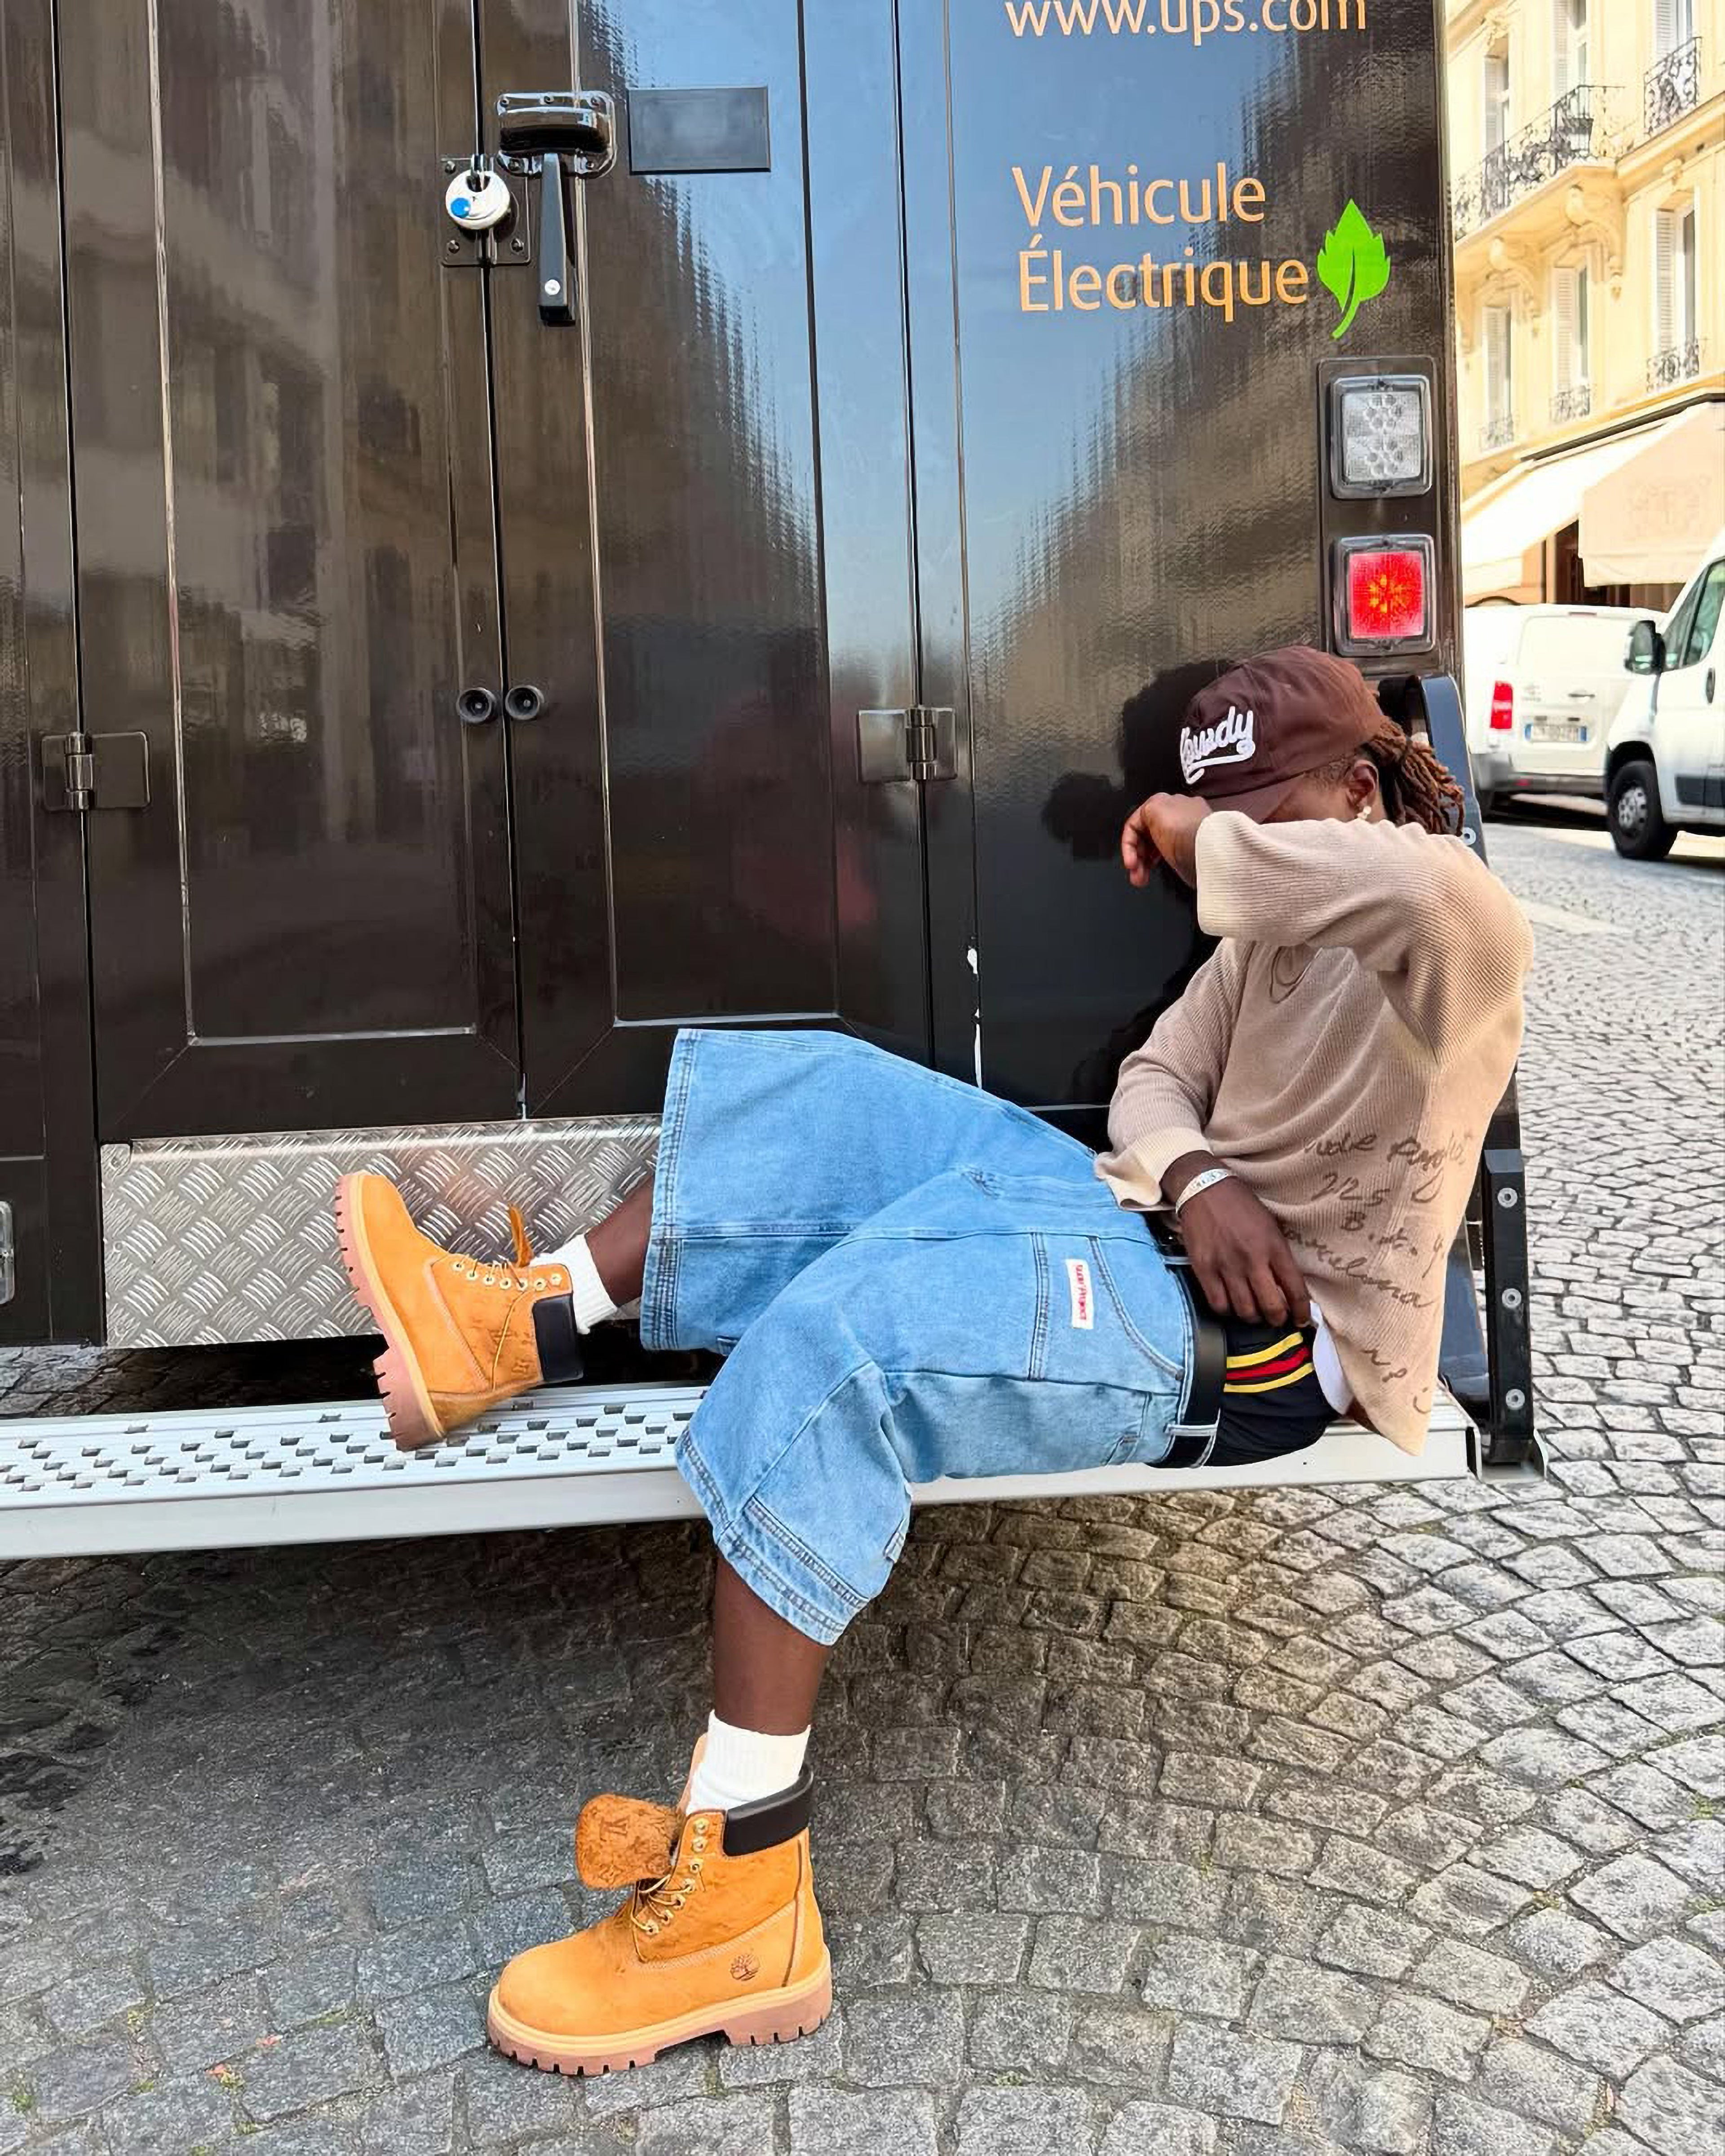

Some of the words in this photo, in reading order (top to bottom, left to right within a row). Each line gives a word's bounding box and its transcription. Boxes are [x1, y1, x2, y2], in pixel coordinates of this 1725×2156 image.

[1005, 0, 1366, 46] www.ups.com
[1012, 162, 1266, 228] Véhicule
[1018, 234, 1309, 322] Électrique
